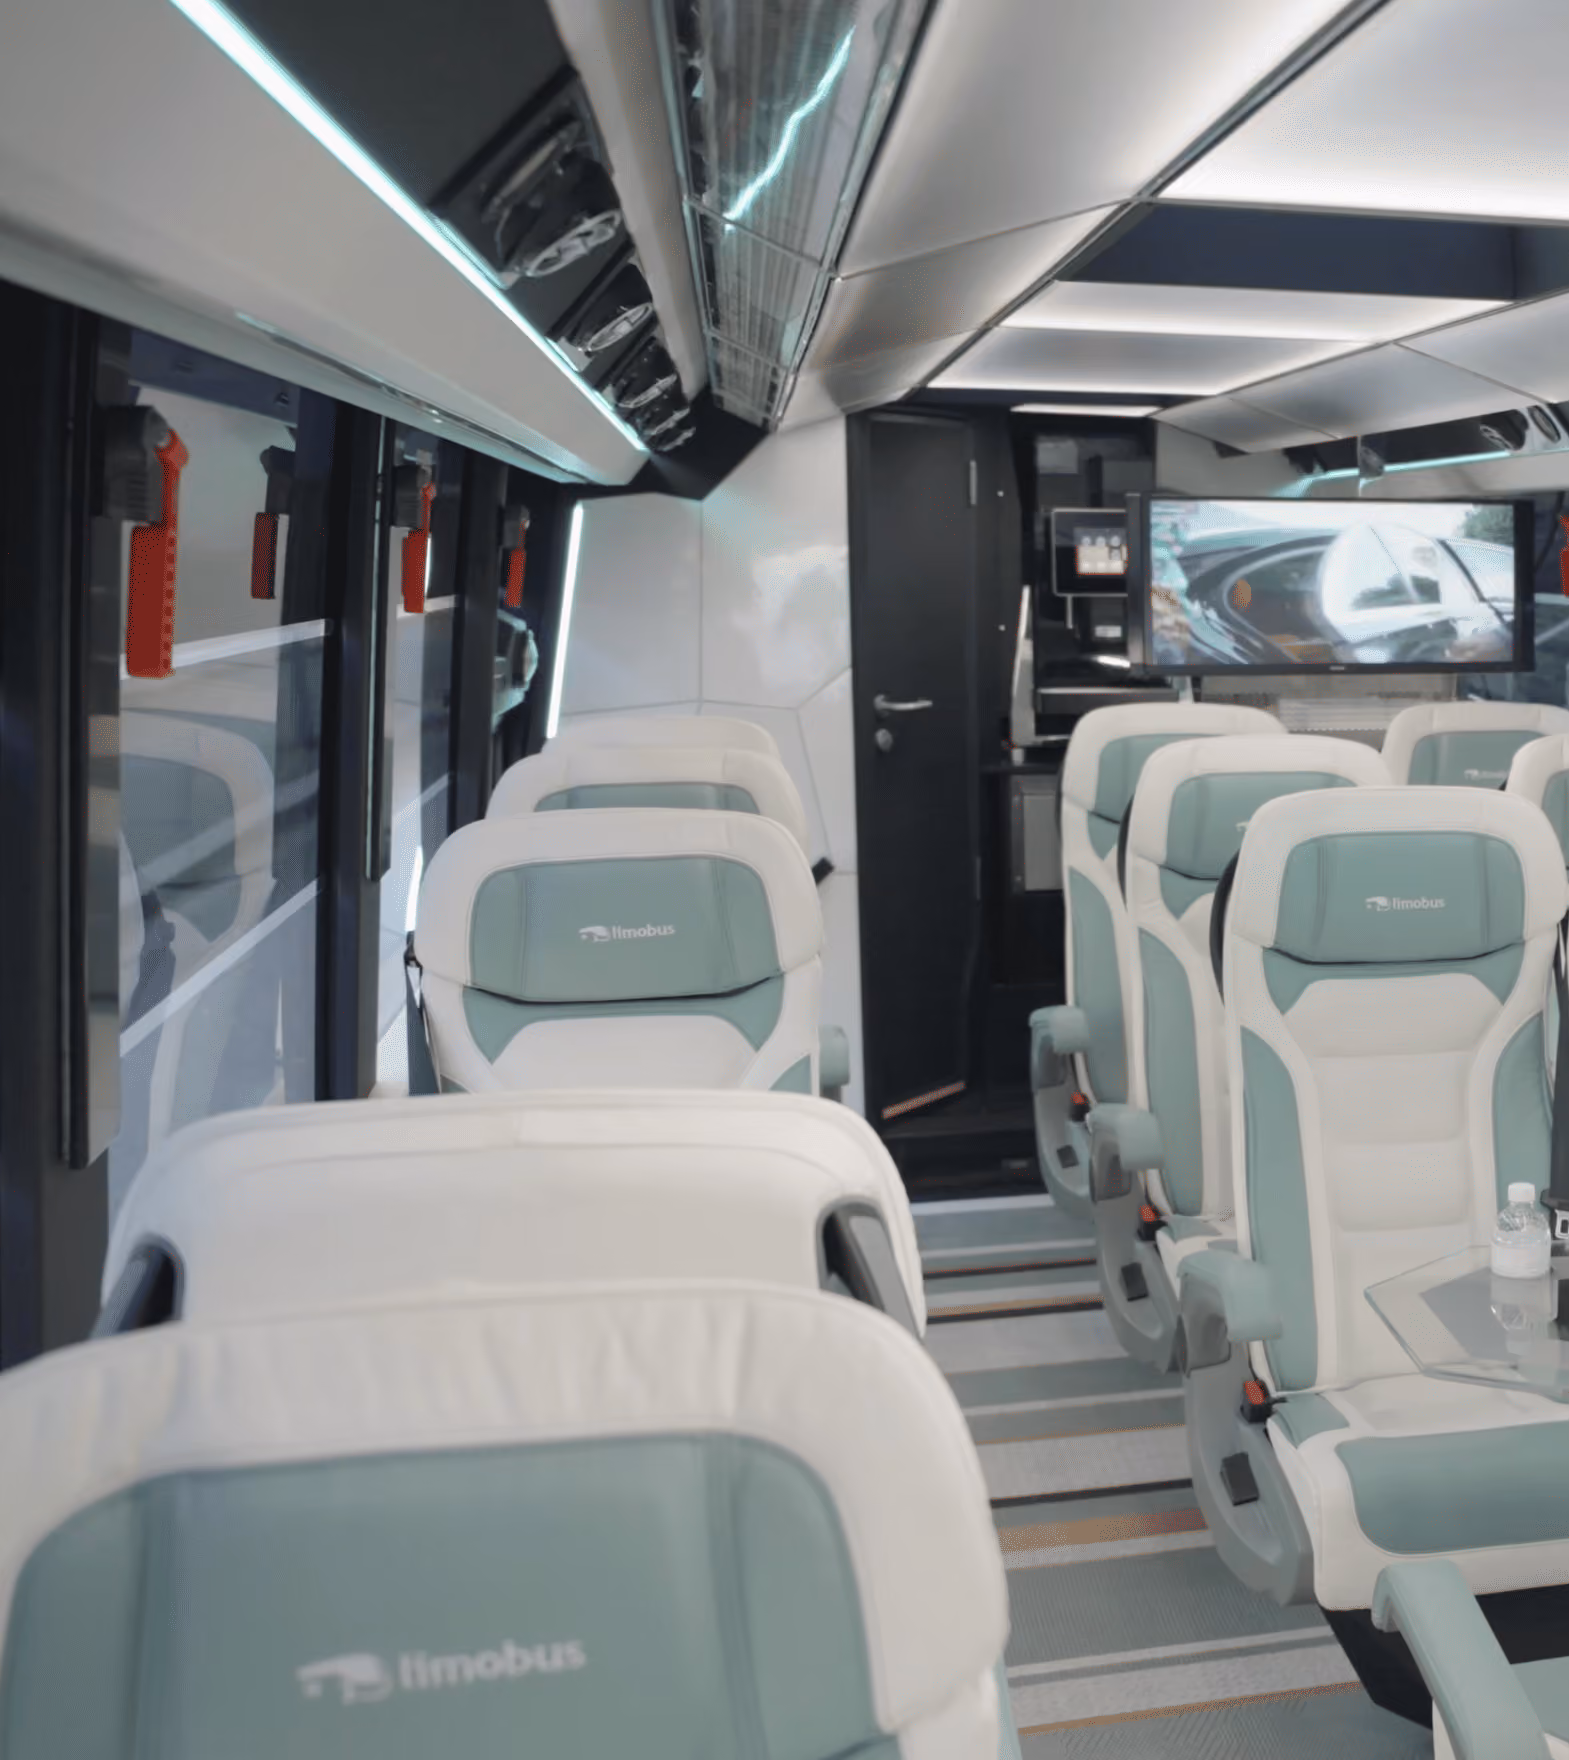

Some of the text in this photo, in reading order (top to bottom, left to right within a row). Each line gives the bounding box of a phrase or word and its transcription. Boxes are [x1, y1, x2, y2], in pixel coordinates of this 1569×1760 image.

[1392, 896, 1446, 909] limobus
[611, 923, 676, 939] limobus
[401, 1639, 587, 1690] limobus
